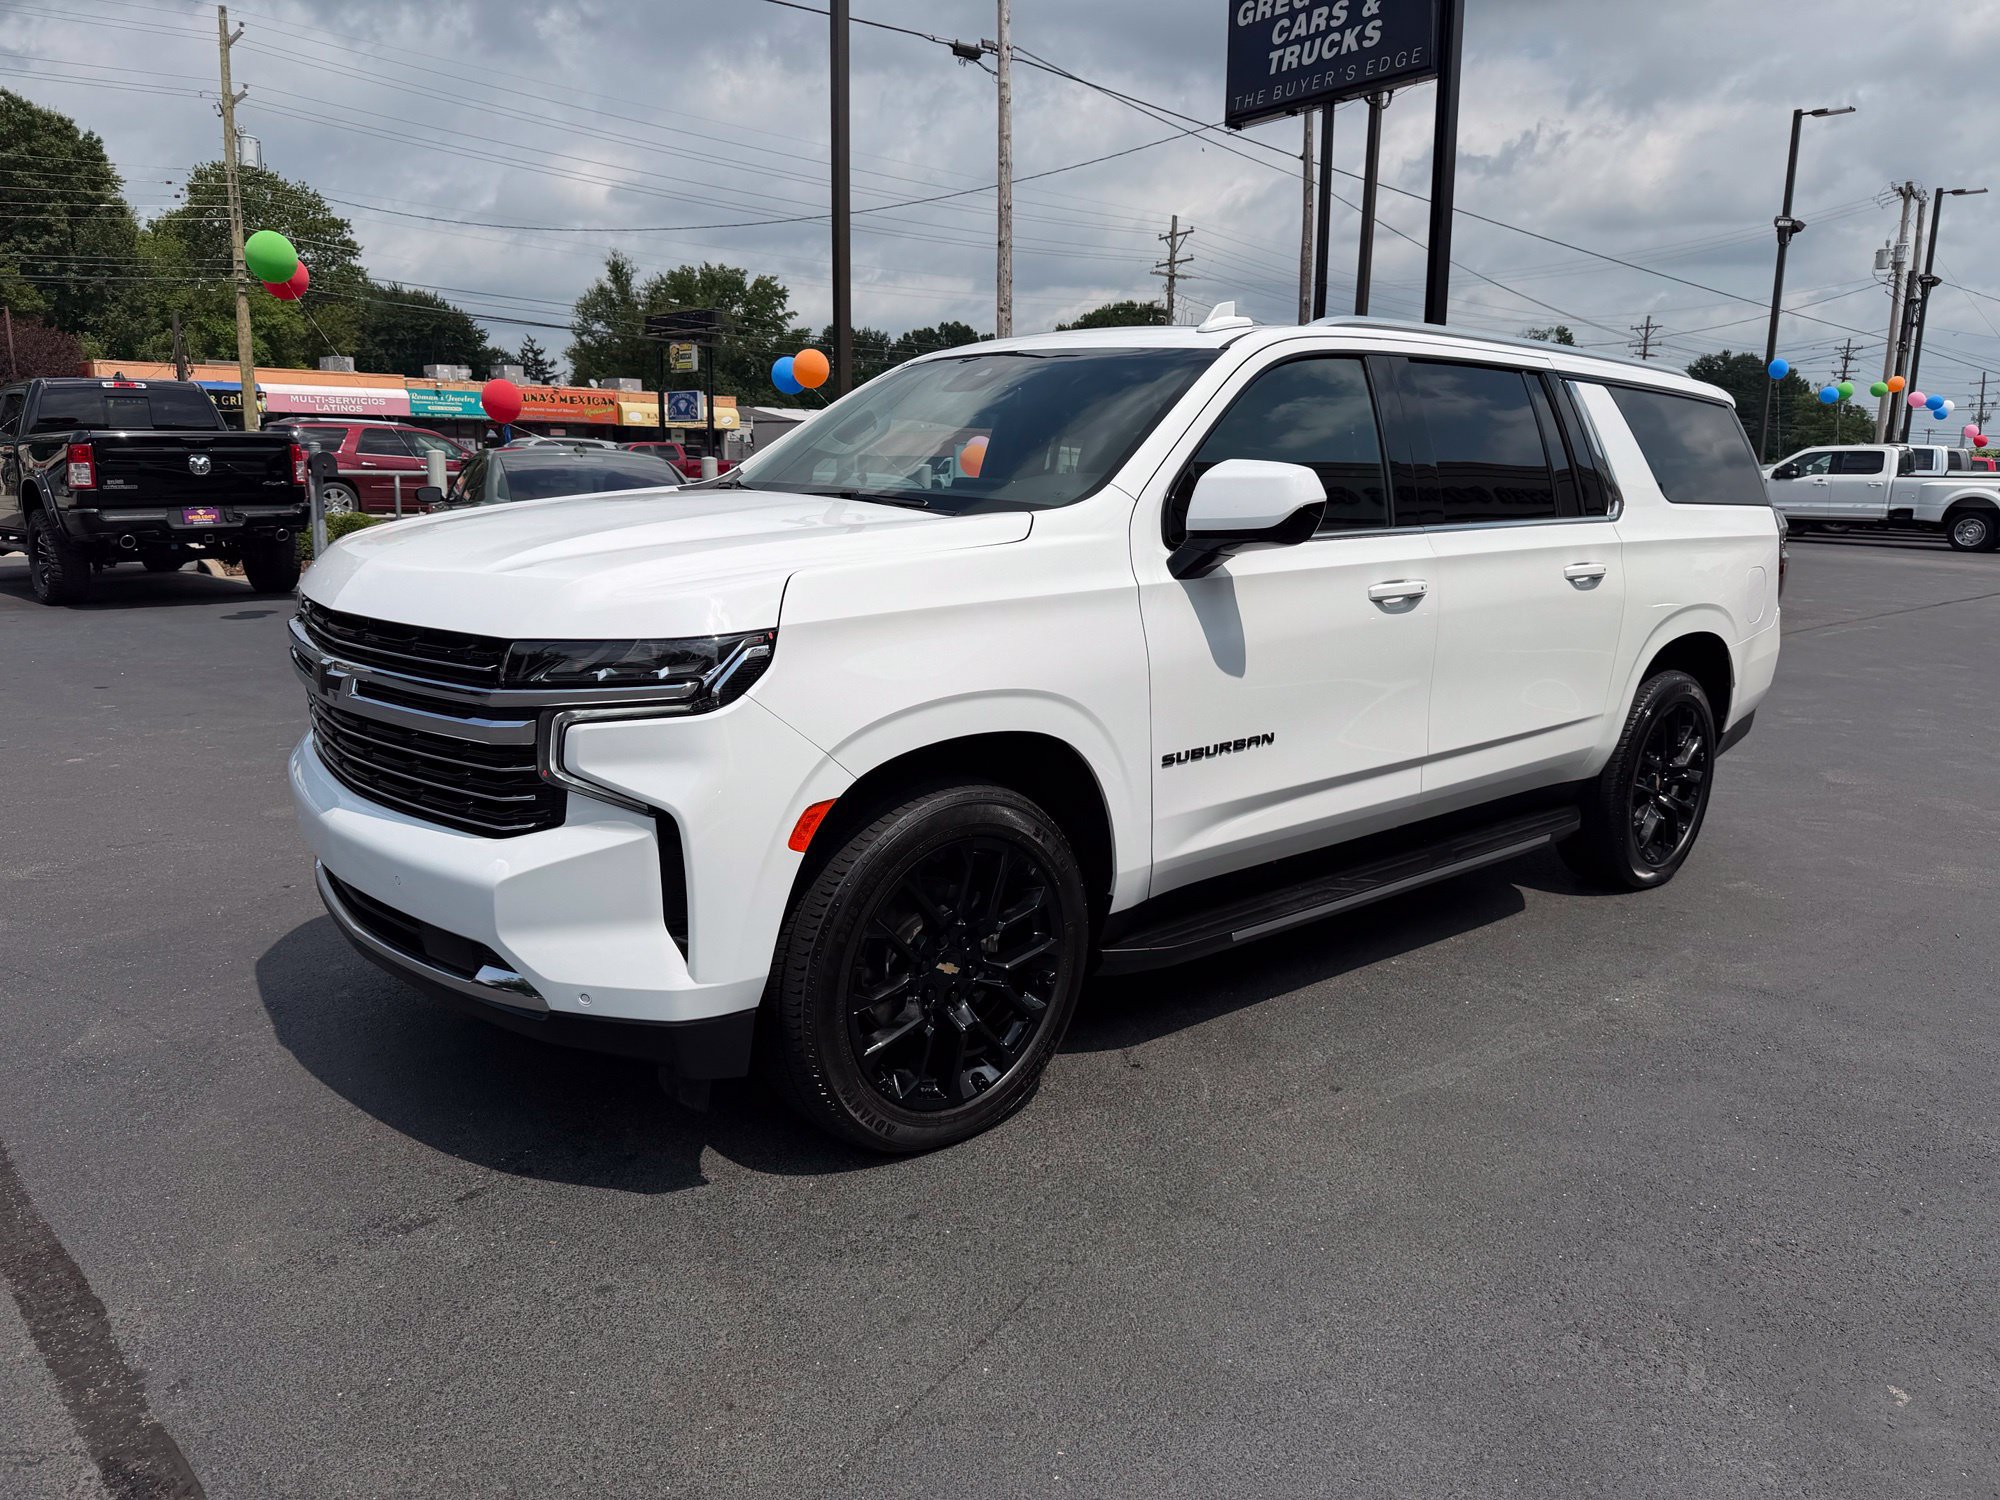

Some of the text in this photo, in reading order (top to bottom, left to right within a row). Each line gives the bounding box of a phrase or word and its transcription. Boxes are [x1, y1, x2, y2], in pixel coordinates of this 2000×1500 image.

[1271, 0, 1381, 46] CARS &
[1268, 19, 1383, 76] TRUCKS
[1234, 46, 1423, 111] THE BUYER'S EDGE
[290, 395, 386, 406] MULTI-SERVICIOS
[315, 403, 364, 413] LATINOS
[445, 393, 475, 404] Jewelry
[559, 395, 615, 406] MEXICAN
[1161, 732, 1275, 769] SUBURBAN
